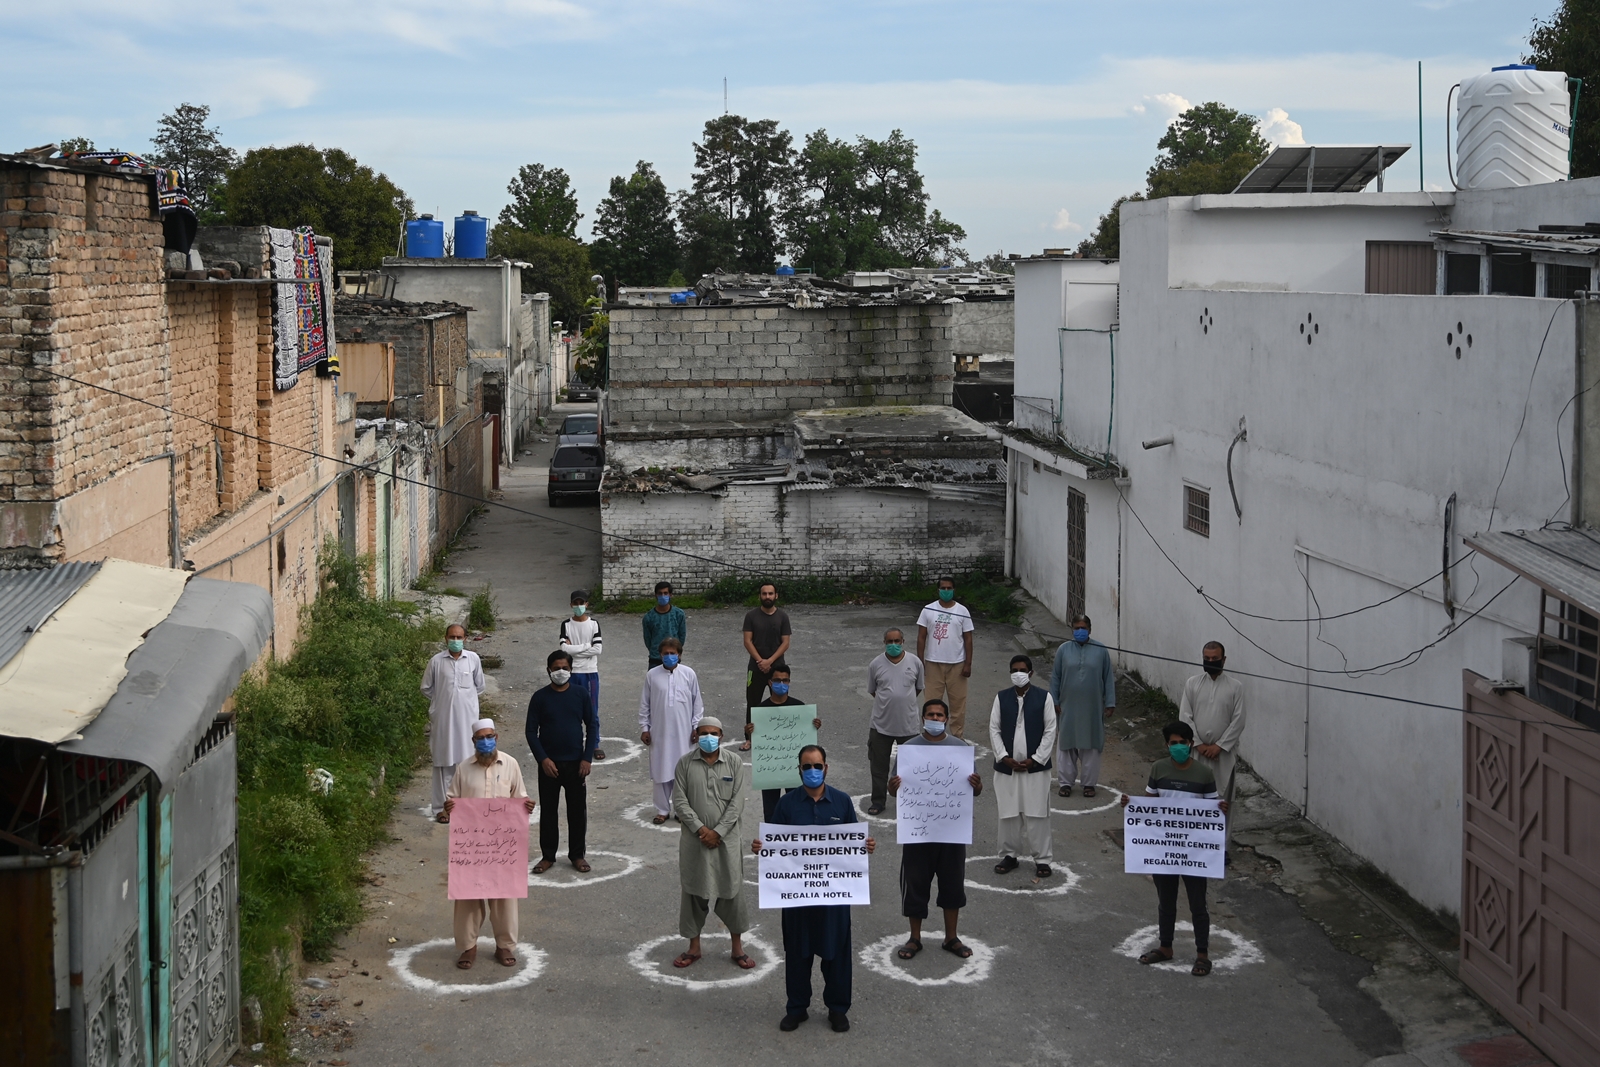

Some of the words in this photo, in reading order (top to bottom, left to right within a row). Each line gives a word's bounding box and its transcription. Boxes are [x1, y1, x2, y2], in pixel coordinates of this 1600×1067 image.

[483, 803, 506, 818] اپیل
[1128, 804, 1158, 814] SAVE
[1160, 806, 1184, 815] THE
[1186, 808, 1220, 818] LIVES
[1127, 818, 1141, 826] OF
[1144, 818, 1162, 827] G-6
[1164, 820, 1224, 831] RESIDENTS
[765, 834, 798, 842] SAVE
[800, 833, 826, 841] THE
[828, 832, 865, 840] LIVES
[1165, 832, 1189, 840] SHIFT
[1132, 838, 1186, 847] QUARANTINE
[1188, 842, 1220, 850] CENTRE
[760, 849, 776, 857] OF
[780, 848, 798, 856] G-6
[802, 847, 866, 856] RESIDENTS
[1165, 852, 1188, 860] FROM
[1144, 858, 1180, 866] REGALIA
[1181, 860, 1208, 868] HOTEL
